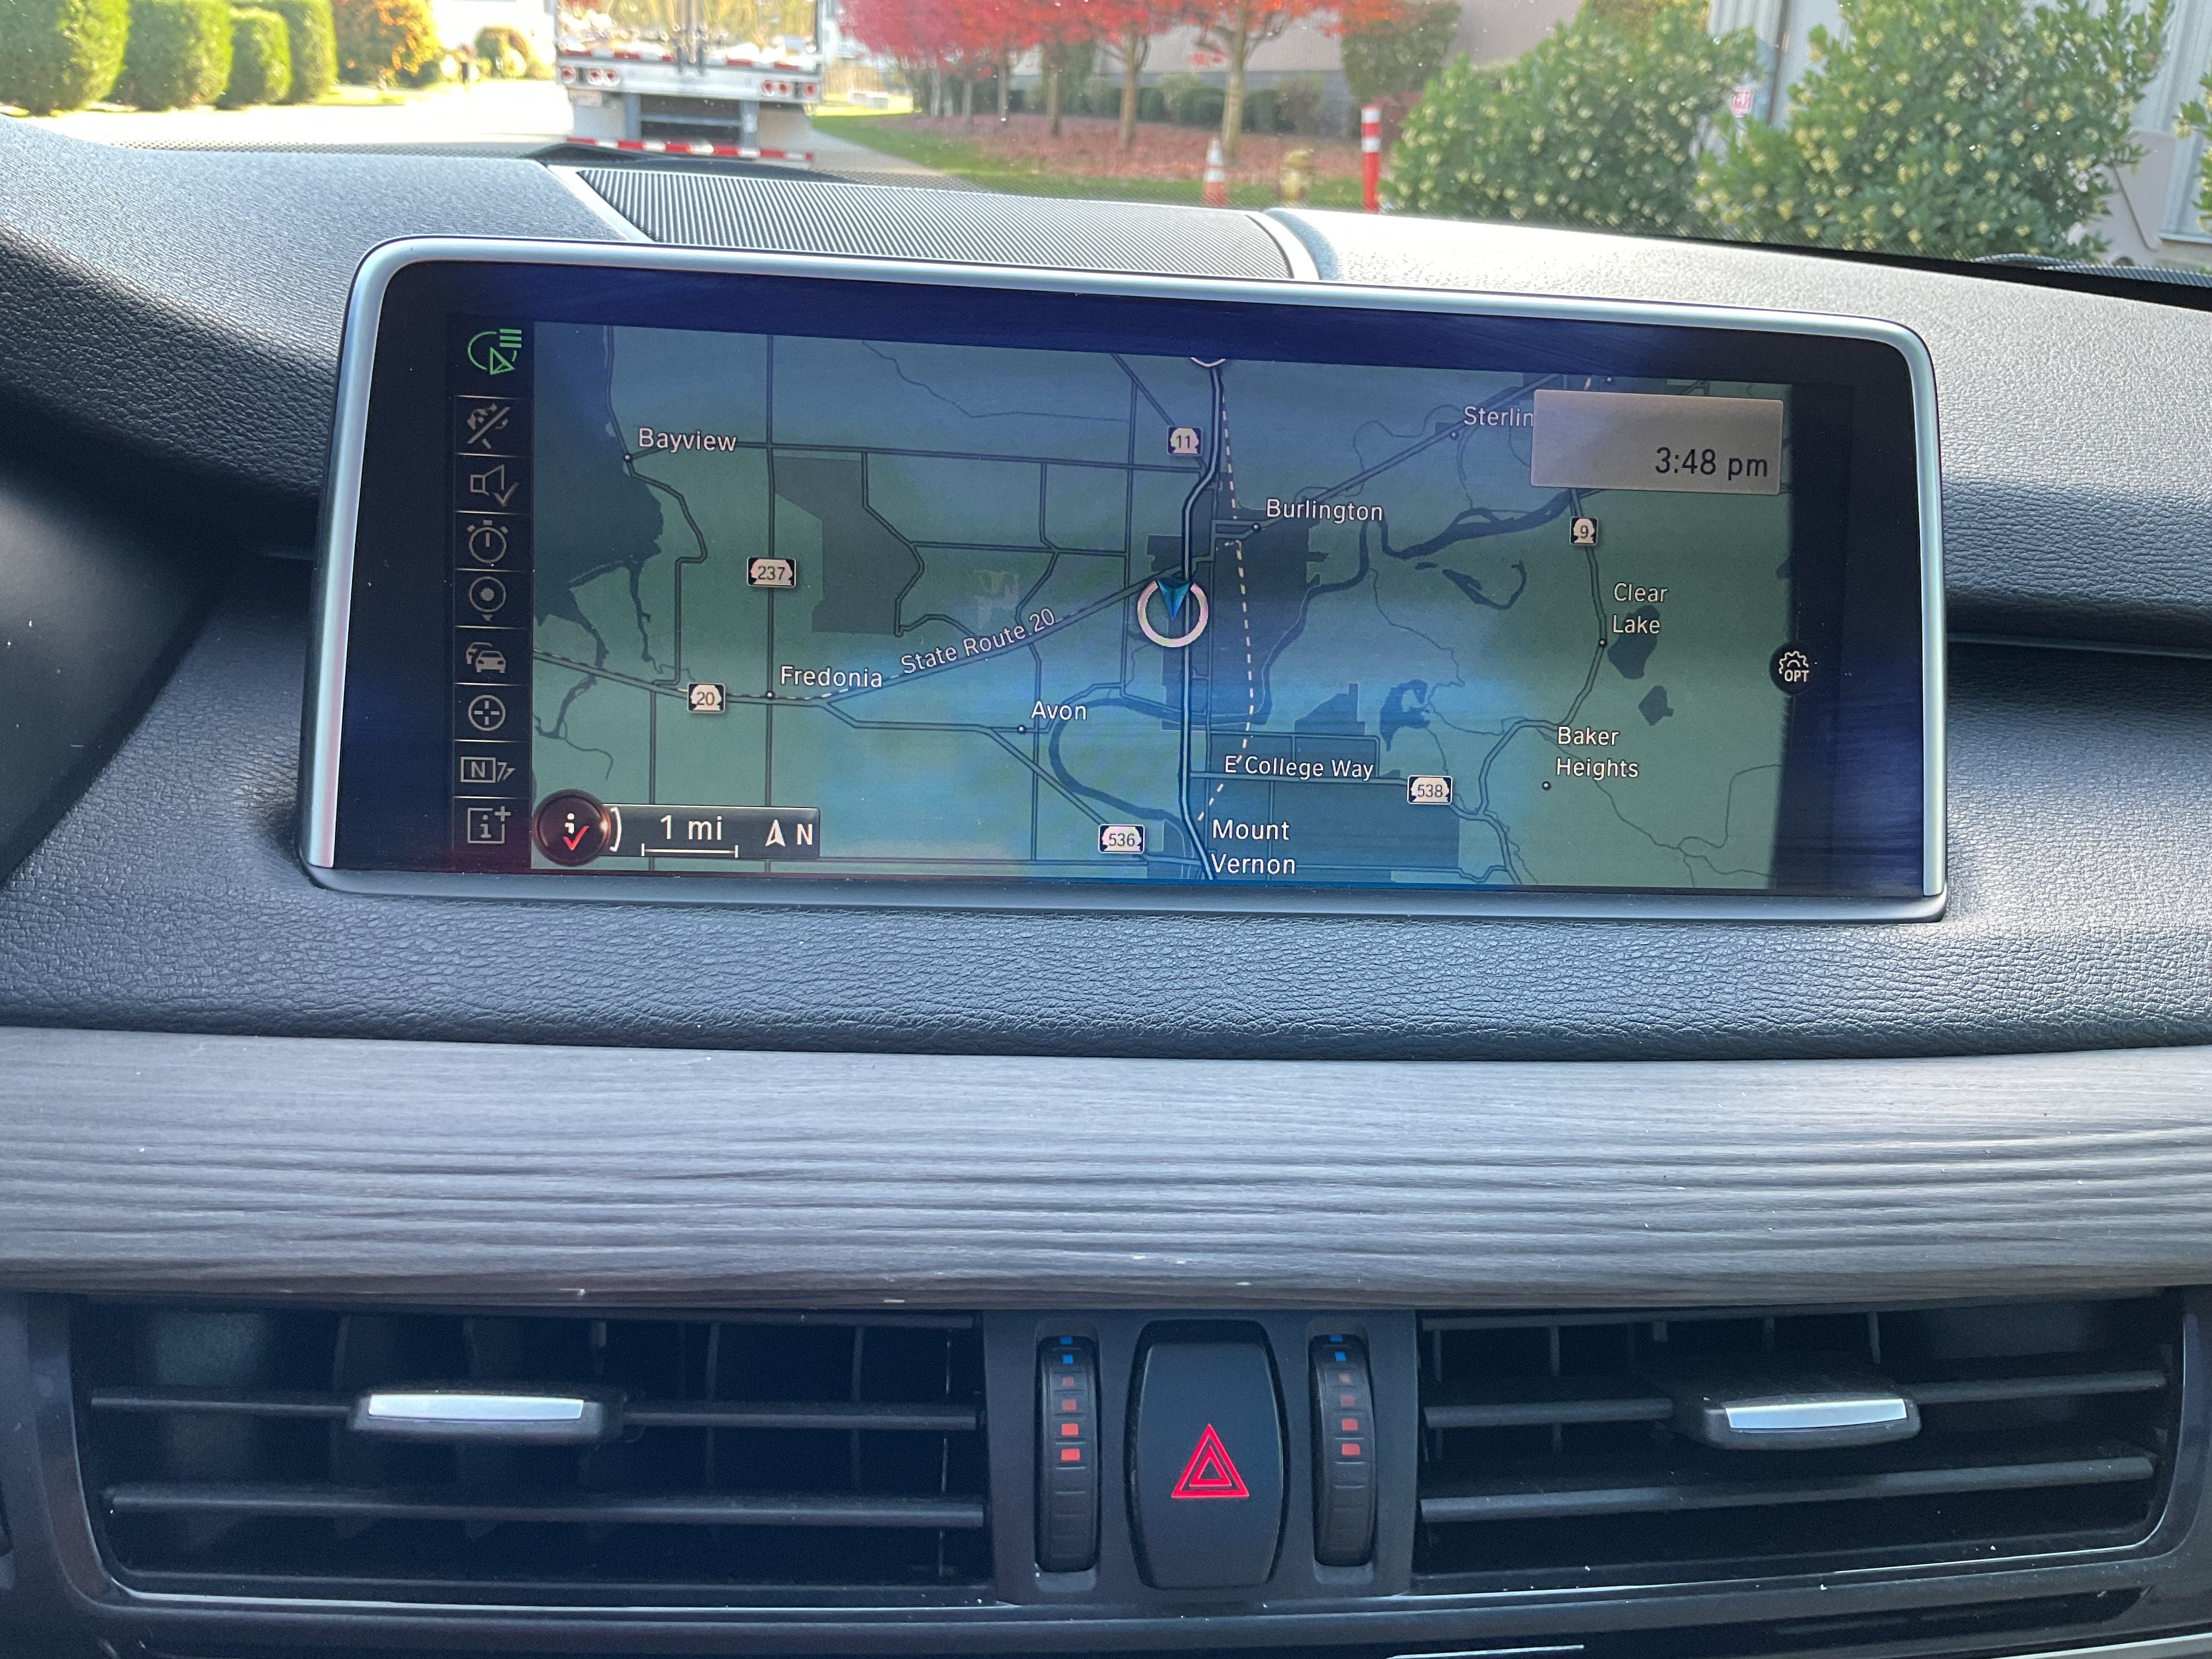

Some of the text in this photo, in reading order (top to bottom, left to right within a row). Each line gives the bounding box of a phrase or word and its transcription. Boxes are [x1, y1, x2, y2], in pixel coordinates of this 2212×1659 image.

[1464, 405, 1533, 427] Sterlin
[637, 427, 737, 453] Bayview
[1176, 435, 1192, 449] 11
[1655, 447, 1768, 481] 3:48 pm
[1266, 498, 1383, 524] Burlington
[1579, 524, 1589, 539] 9
[757, 565, 786, 580] 237
[1613, 583, 1668, 603] Clear
[1613, 614, 1661, 634] Lake
[901, 608, 1055, 674] State Route 20
[781, 665, 883, 688] Fredonia
[1784, 669, 1809, 682] OPT
[696, 691, 715, 706] 20
[1031, 701, 1087, 720] Avon
[1557, 726, 1620, 747] Baker
[1224, 755, 1374, 781] E College Way
[1556, 758, 1639, 780] Heights
[1417, 784, 1443, 798] 538
[661, 816, 723, 842] 1 mi
[797, 824, 813, 845] N
[1212, 820, 1290, 841] Mount
[1108, 833, 1136, 847] 536
[1210, 854, 1296, 874] Vernon
